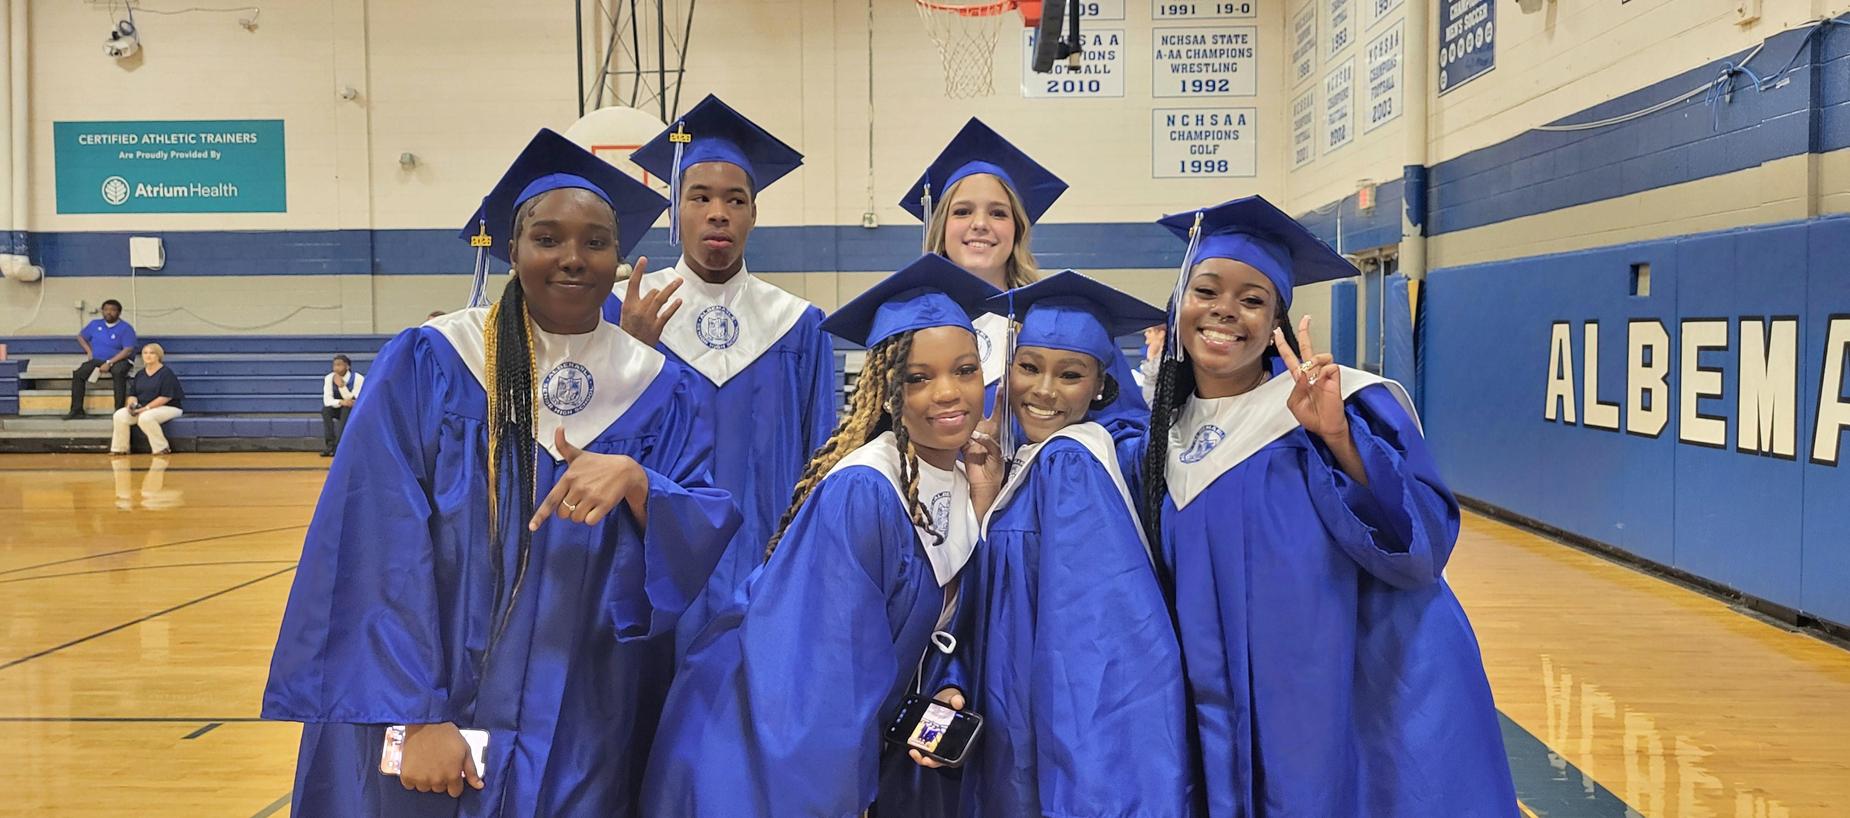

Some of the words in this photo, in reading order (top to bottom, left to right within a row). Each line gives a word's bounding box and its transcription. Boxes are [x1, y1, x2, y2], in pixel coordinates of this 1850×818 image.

[1160, 4, 1195, 16] 1991
[1217, 3, 1251, 14] 19-0
[1161, 35, 1206, 46] NCHSAA
[1211, 34, 1248, 45] STATE
[1156, 49, 1182, 60] A-AA
[1186, 48, 1253, 59] CHAMPIONS
[1170, 62, 1238, 73] WRESTLING
[1047, 80, 1100, 93] 2010
[1181, 79, 1229, 93] 1992
[1372, 97, 1392, 123] 2003
[1166, 113, 1247, 127] NCHSAA
[78, 134, 138, 145] CERTIFIED
[141, 133, 196, 144] ATHLETIC
[199, 132, 257, 144] TRAINERS
[1170, 130, 1239, 141] CHAMPIONS
[118, 151, 133, 160] Are
[136, 151, 168, 161] Proudly
[170, 150, 208, 160] Provided
[210, 150, 221, 161] By
[1190, 144, 1220, 155] GOLF
[1180, 160, 1229, 173] 1998
[548, 361, 592, 380] ALBEMARLE
